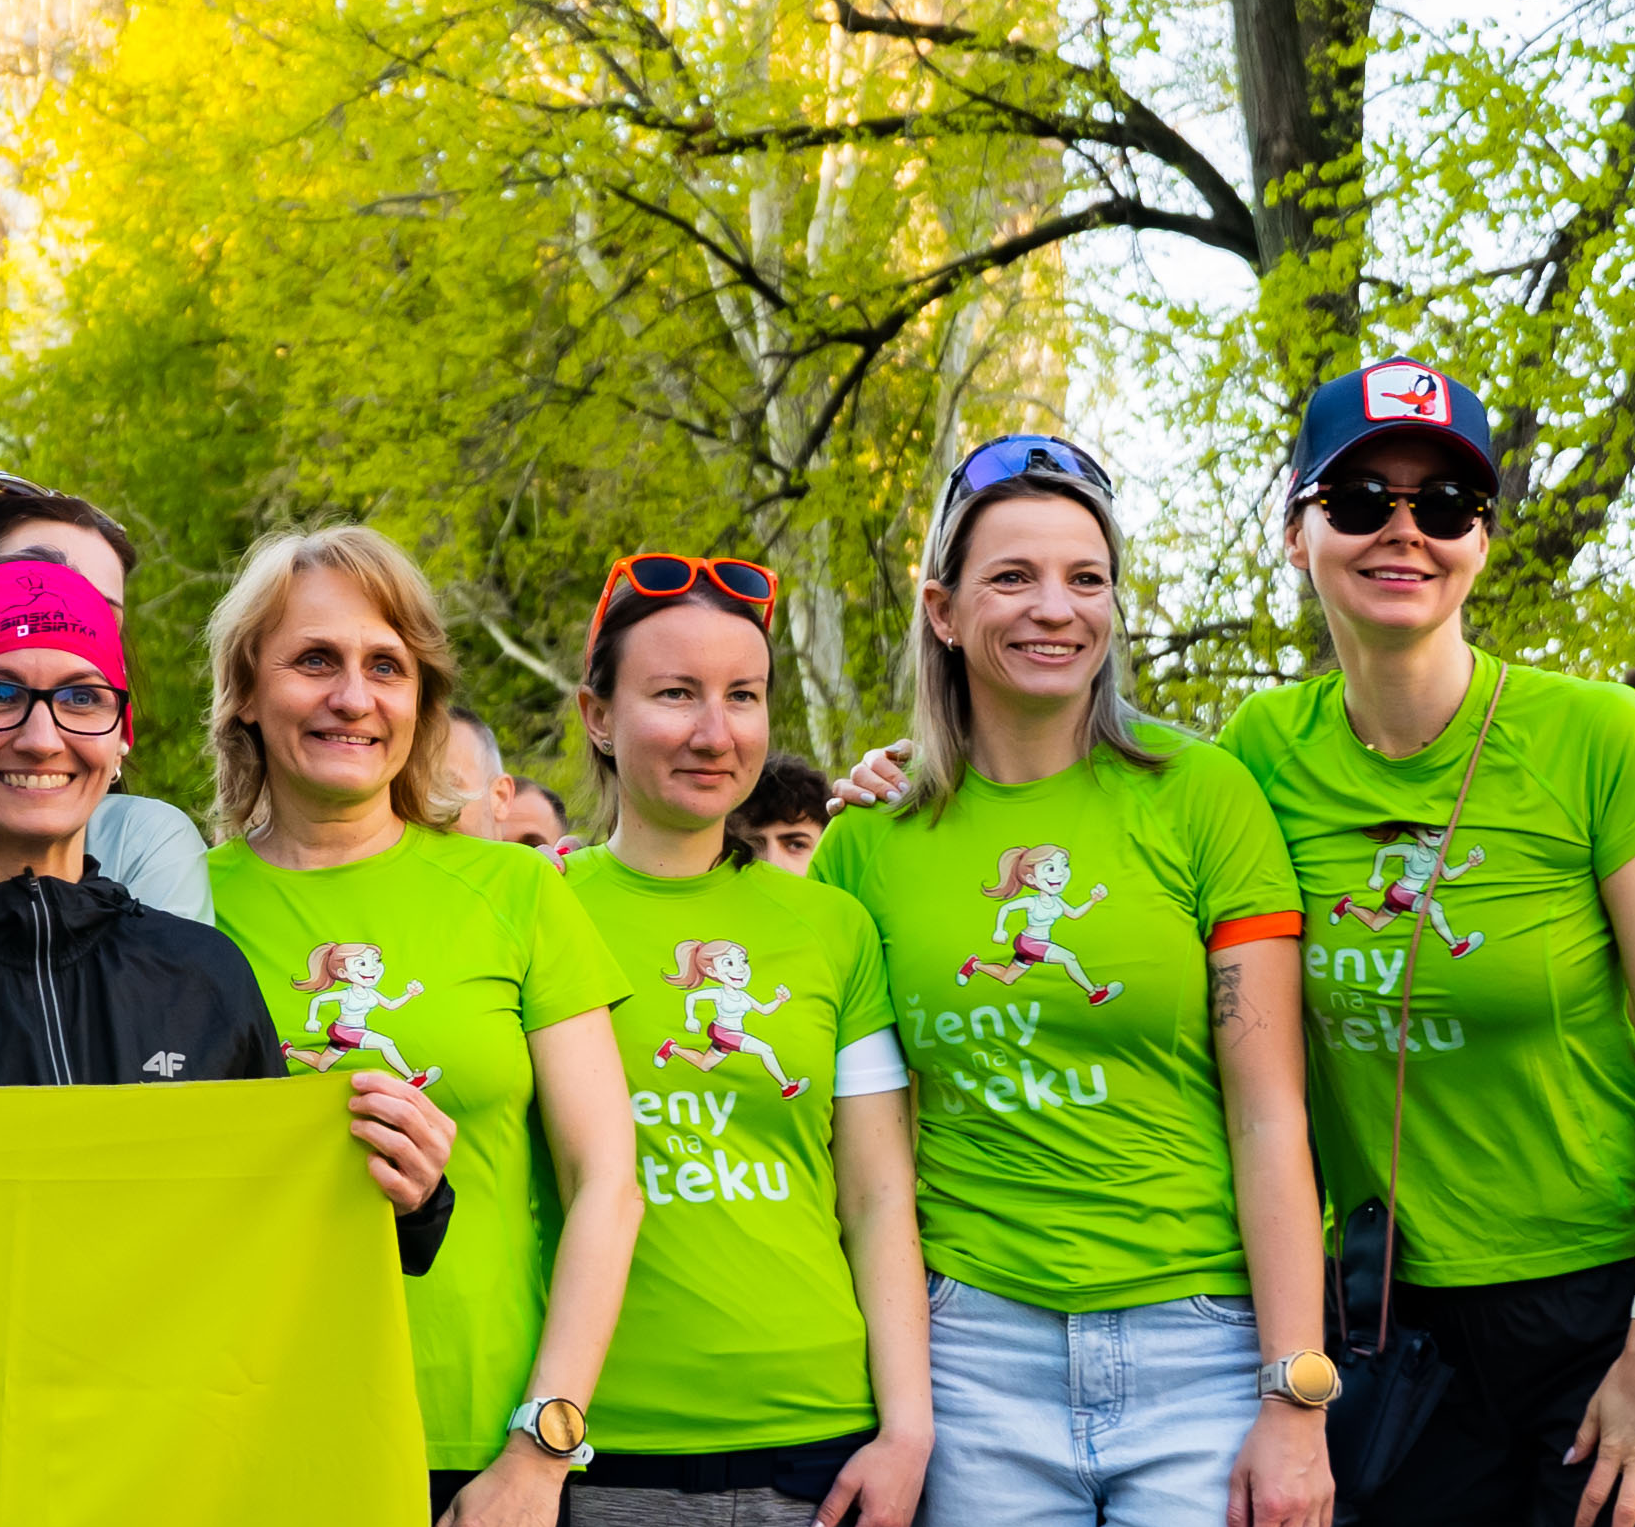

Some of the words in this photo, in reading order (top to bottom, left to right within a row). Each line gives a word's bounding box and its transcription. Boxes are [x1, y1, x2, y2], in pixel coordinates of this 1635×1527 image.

[1305, 943, 1405, 995] eny
[906, 994, 1041, 1049] Ženy
[1330, 992, 1364, 1009] na
[1313, 1006, 1465, 1053] teku
[143, 1051, 186, 1078] 4F
[971, 1049, 1008, 1068] na
[630, 1090, 737, 1137] eny
[666, 1135, 703, 1154] na
[642, 1149, 791, 1205] teku
